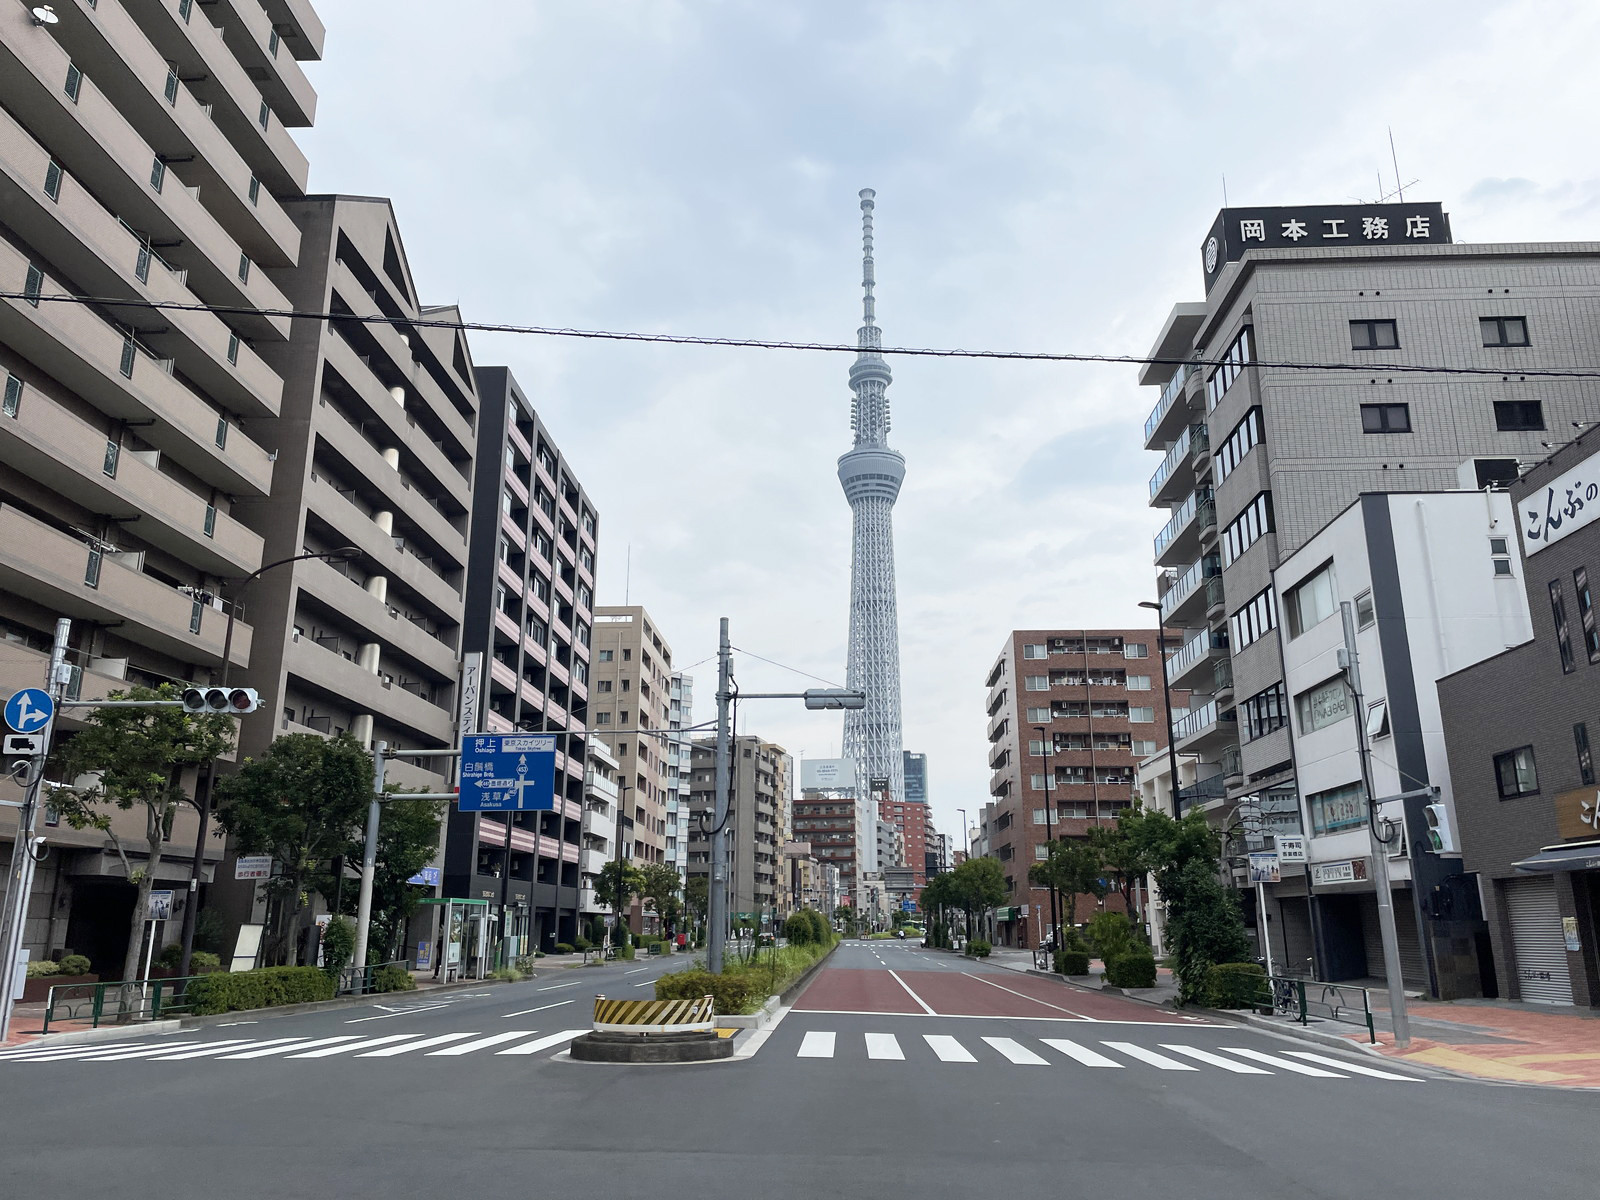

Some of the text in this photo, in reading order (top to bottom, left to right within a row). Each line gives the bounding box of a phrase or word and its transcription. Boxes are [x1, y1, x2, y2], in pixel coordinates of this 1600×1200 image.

[1239, 215, 1430, 242] 岡本工務店
[1527, 481, 1599, 543] こんぶの
[475, 738, 496, 748] 押上
[503, 739, 553, 747] 東京スカイツリー
[480, 792, 502, 802] 浅草
